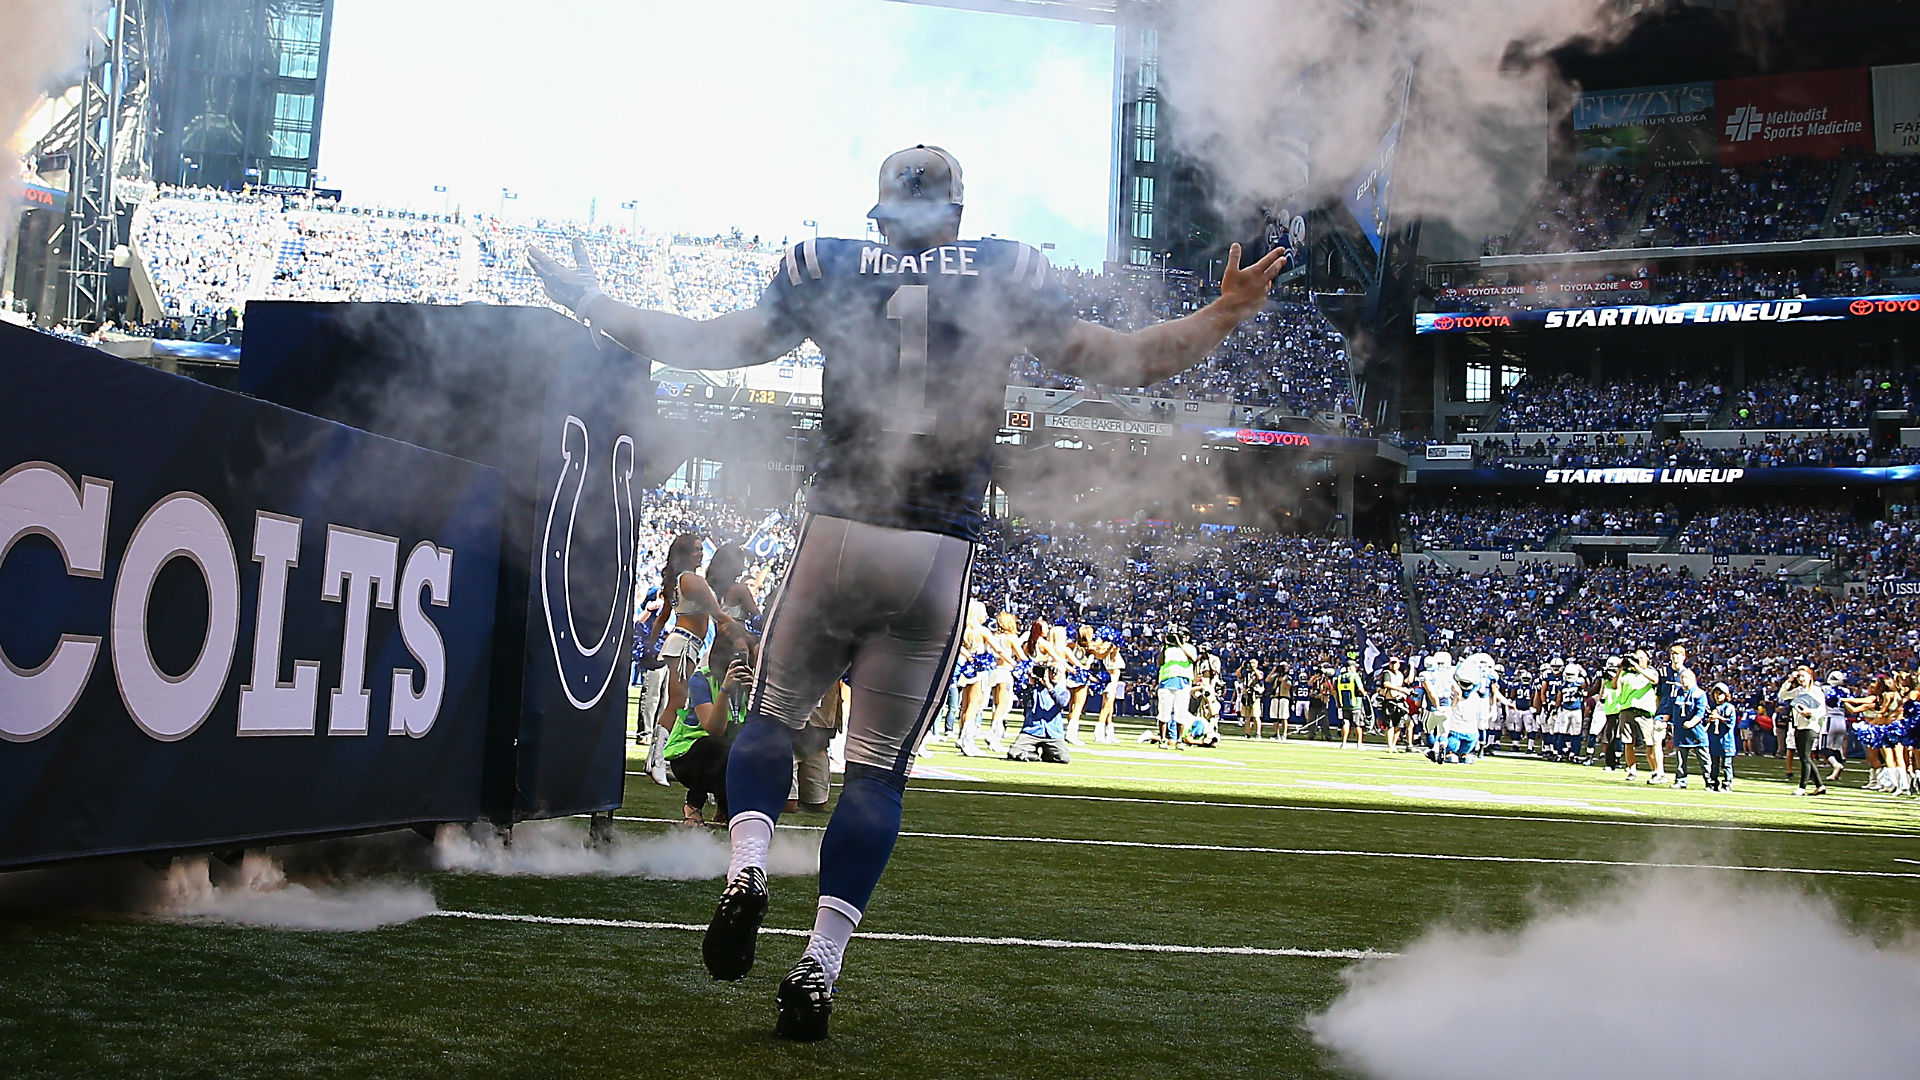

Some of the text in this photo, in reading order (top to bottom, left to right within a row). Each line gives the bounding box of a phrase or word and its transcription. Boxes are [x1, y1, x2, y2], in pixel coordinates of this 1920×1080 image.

[1579, 86, 1707, 121] FUZZY'S
[1669, 114, 1707, 124] VODKA
[1766, 106, 1828, 125] Methodist
[1763, 120, 1862, 141] Sports Medicine
[859, 246, 979, 276] MCAFEE
[1467, 286, 1525, 296] TOYOTA ZONE
[1559, 282, 1619, 292] TOYOTA ZONE
[1455, 315, 1511, 328] TOYOTA
[1544, 302, 1803, 329] STARTING LINEUP
[886, 284, 937, 435] 1
[705, 386, 714, 399] 0
[748, 390, 776, 404] 7:32
[1011, 413, 1030, 427] 25
[1052, 416, 1090, 430] FAEGRE
[1091, 419, 1121, 431] BAKER
[1256, 431, 1310, 446] TOYOTA
[1544, 468, 1745, 484] STARTING LINEUP
[1501, 552, 1514, 561] 105
[1713, 555, 1728, 564] 105
[0, 460, 453, 743] COLTS
